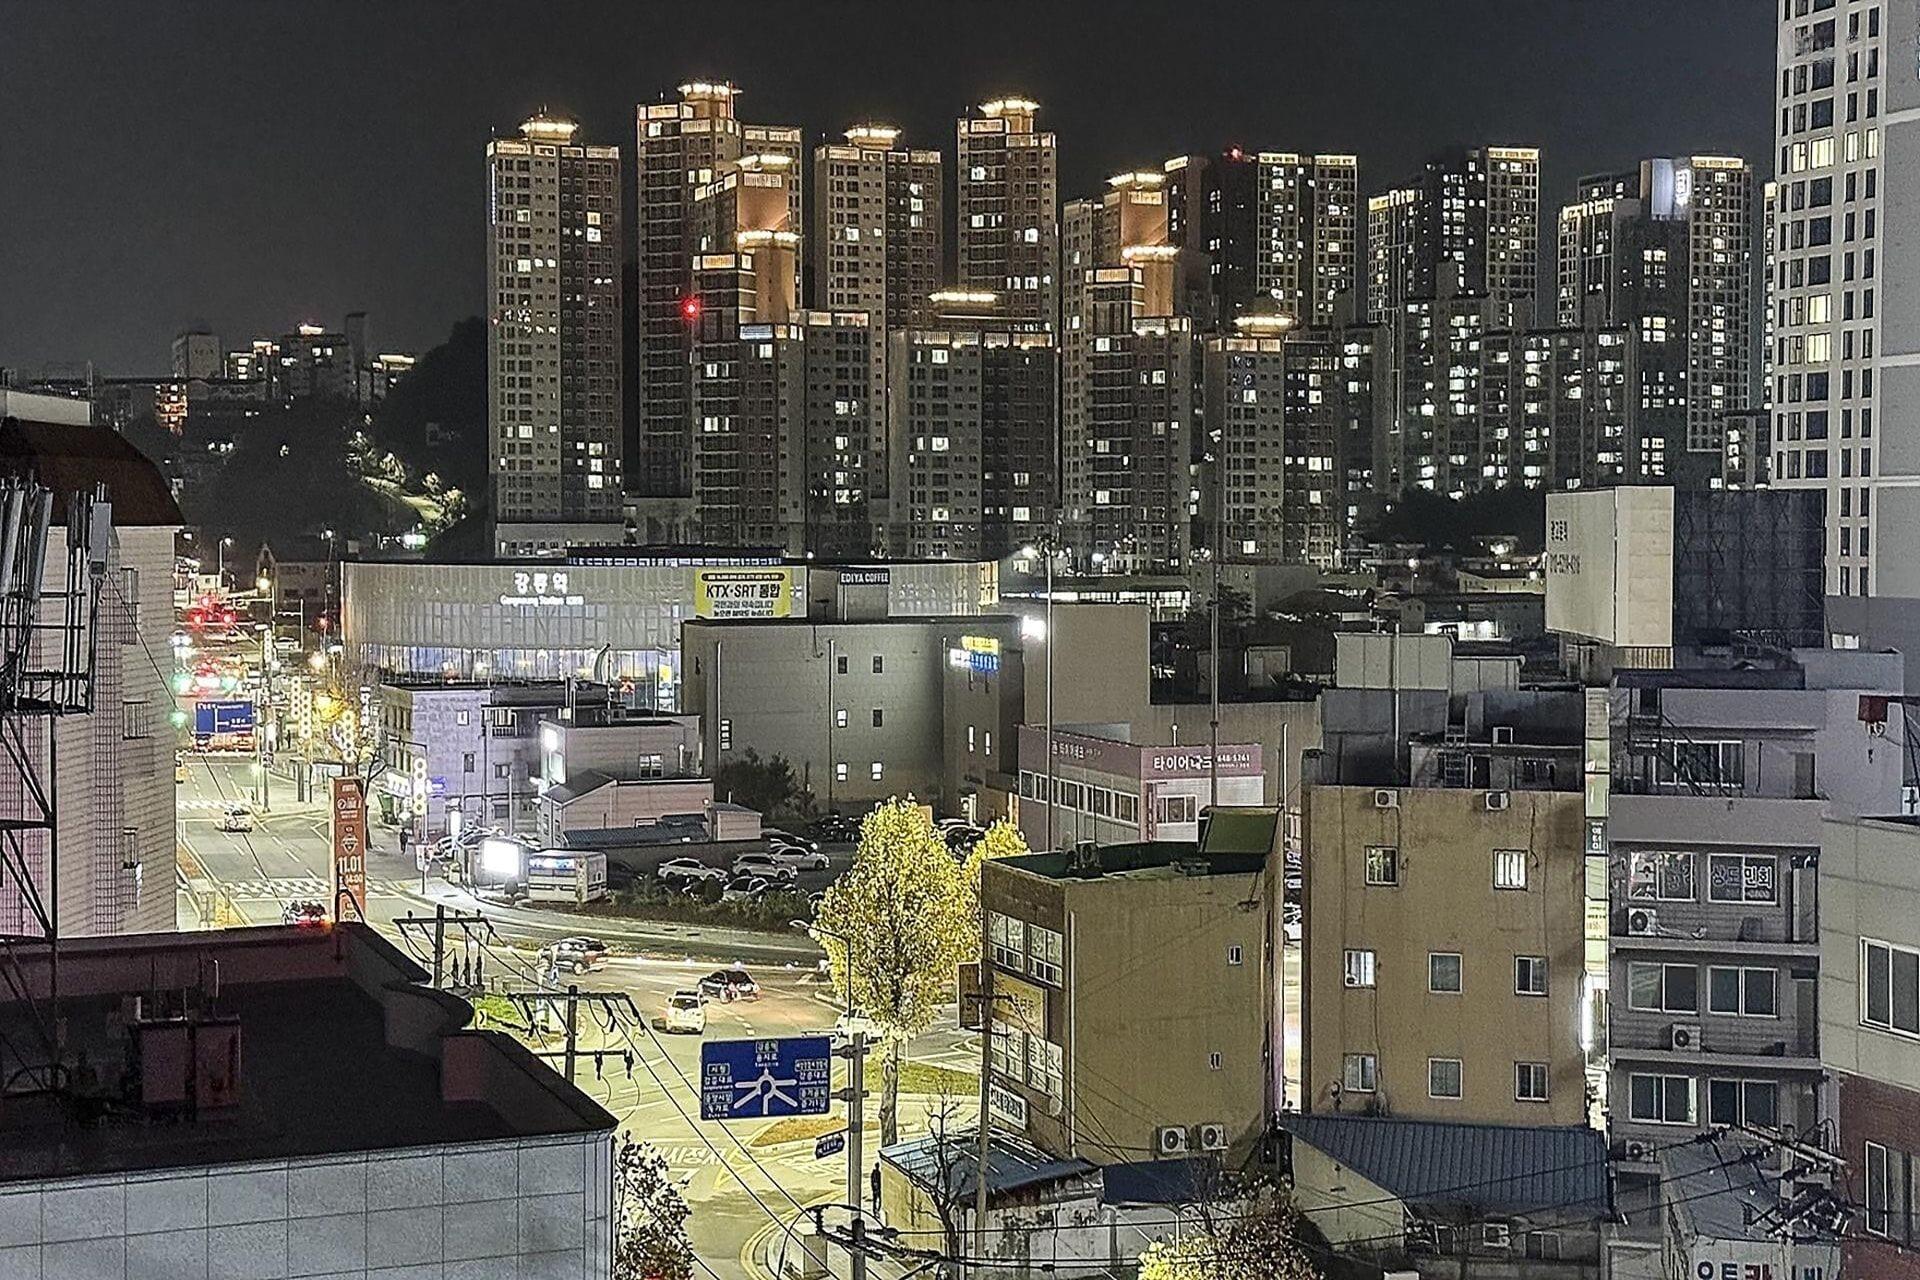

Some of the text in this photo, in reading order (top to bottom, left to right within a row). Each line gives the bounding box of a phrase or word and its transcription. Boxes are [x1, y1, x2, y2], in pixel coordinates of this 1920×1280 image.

[514, 572, 568, 594] 강릉역
[841, 573, 864, 583] EDIYA
[338, 855, 362, 874] 11.01
